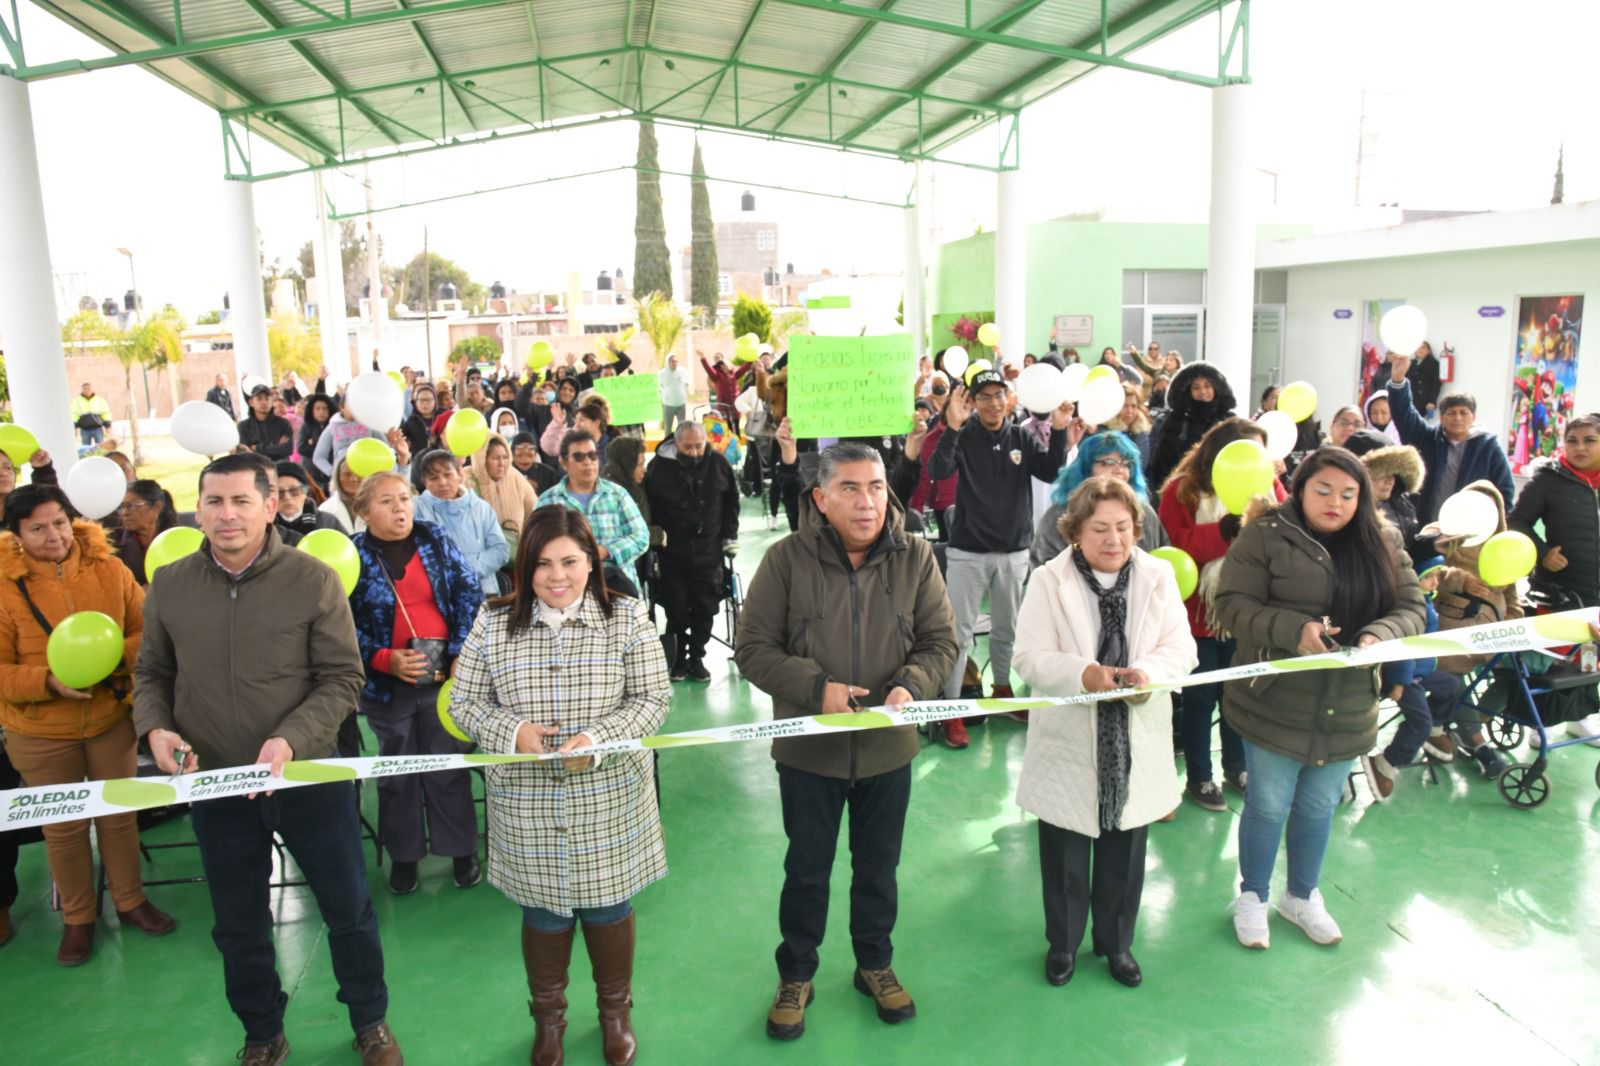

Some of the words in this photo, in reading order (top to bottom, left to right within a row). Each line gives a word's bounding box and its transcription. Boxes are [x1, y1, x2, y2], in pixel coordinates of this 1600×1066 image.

[790, 341, 854, 368] Gracias
[188, 786, 212, 798] sin
[8, 808, 31, 822] sin
